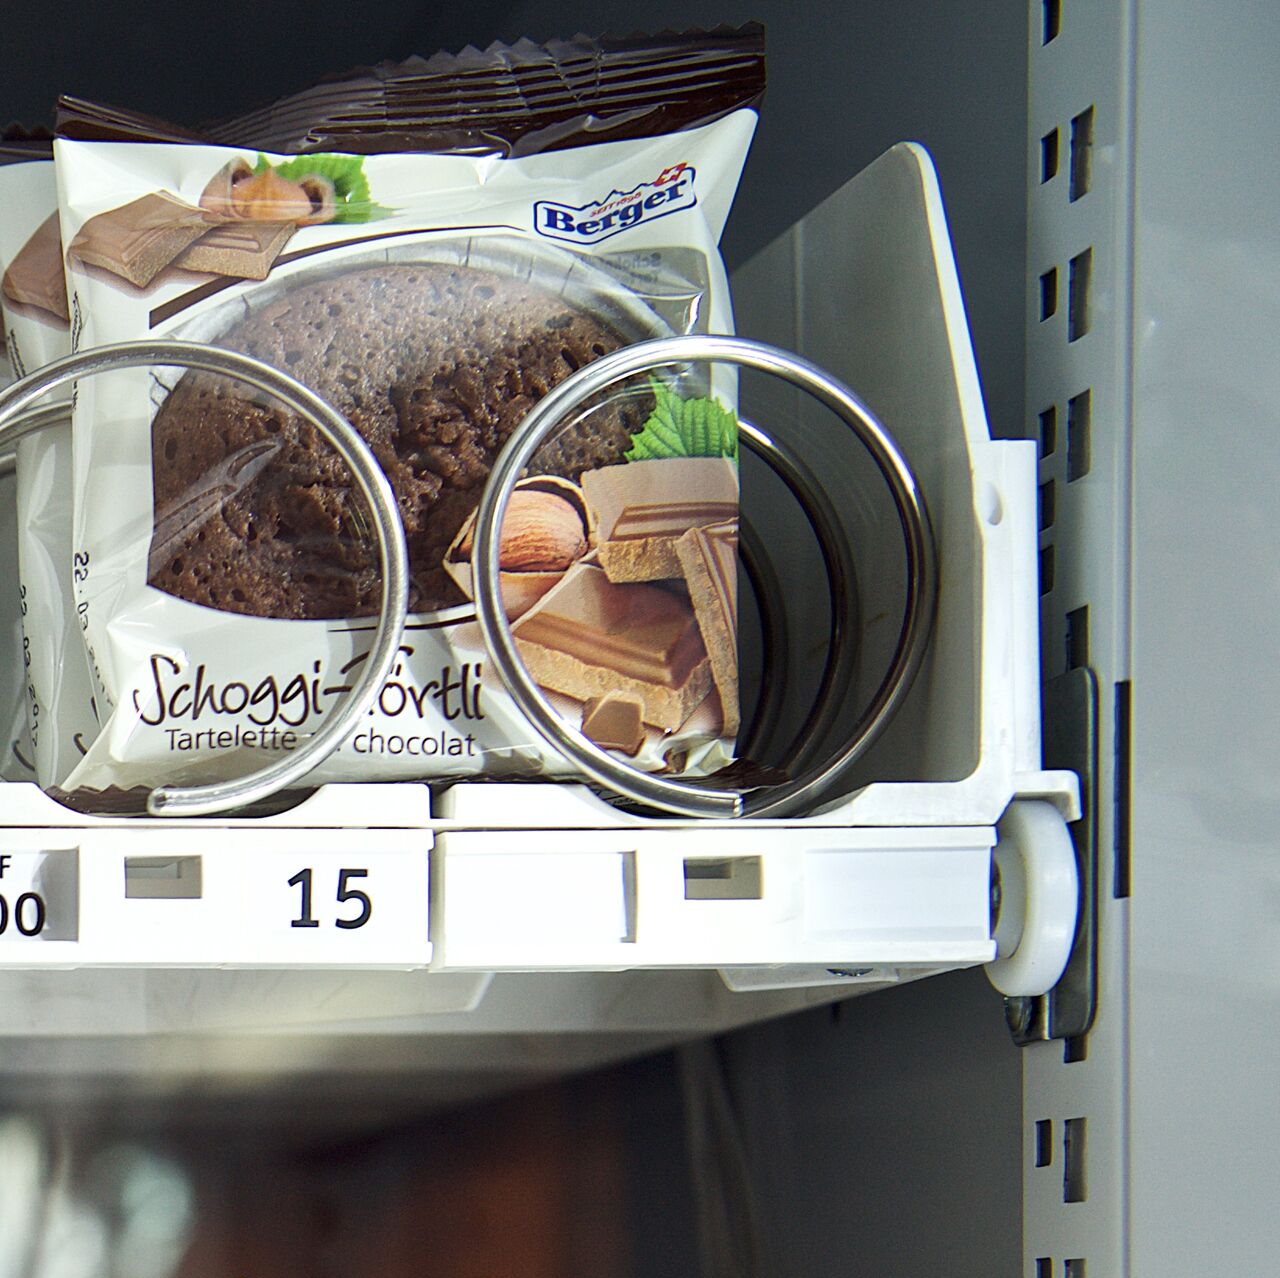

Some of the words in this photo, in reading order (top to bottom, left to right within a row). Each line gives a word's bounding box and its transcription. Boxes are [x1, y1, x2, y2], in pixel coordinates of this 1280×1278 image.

[543, 179, 688, 236] Berger
[164, 728, 298, 752] Tartelette
[353, 728, 476, 757] chocolat
[287, 867, 373, 931] 15
